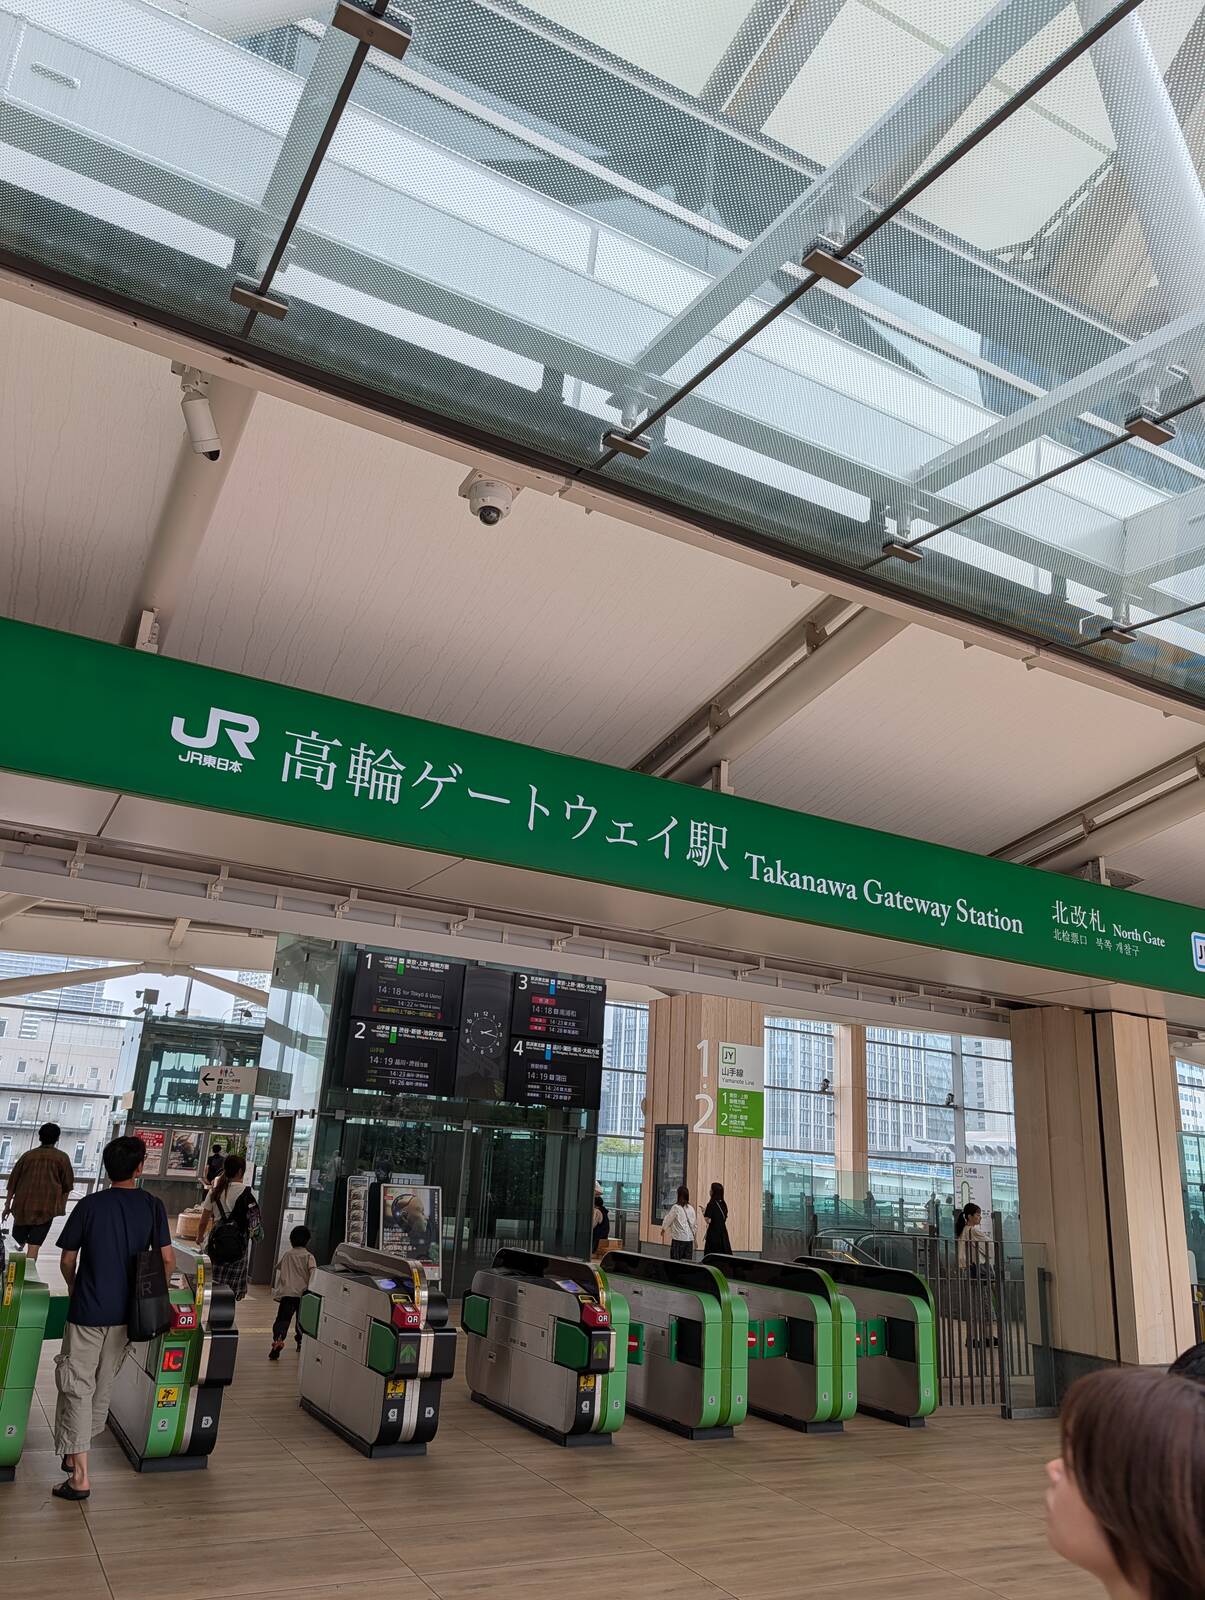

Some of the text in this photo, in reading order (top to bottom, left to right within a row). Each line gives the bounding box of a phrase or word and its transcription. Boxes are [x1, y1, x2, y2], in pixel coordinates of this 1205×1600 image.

[171, 707, 260, 761] JR
[178, 751, 243, 773] JR東日本
[281, 730, 729, 871] 高輪ゲートウェイ駅
[744, 851, 1024, 934] Takanawa Gateway Station
[1051, 900, 1106, 933] 北改札
[1112, 924, 1166, 947] North Gate
[1199, 945, 1205, 960] J
[365, 953, 373, 970] 1
[518, 975, 528, 990] 3
[354, 1022, 366, 1039] 2
[513, 1040, 524, 1056] 4
[724, 1050, 734, 1060] JY
[697, 1040, 709, 1078] 1
[721, 1067, 744, 1078] 山手線
[722, 1092, 727, 1105] 1
[693, 1093, 714, 1134] 2
[720, 1112, 728, 1126] 2
[179, 1315, 194, 1326] QR
[407, 1315, 419, 1324] QR
[162, 1350, 184, 1371] IC
[7, 1426, 14, 1435] 2
[160, 1420, 167, 1428] 2
